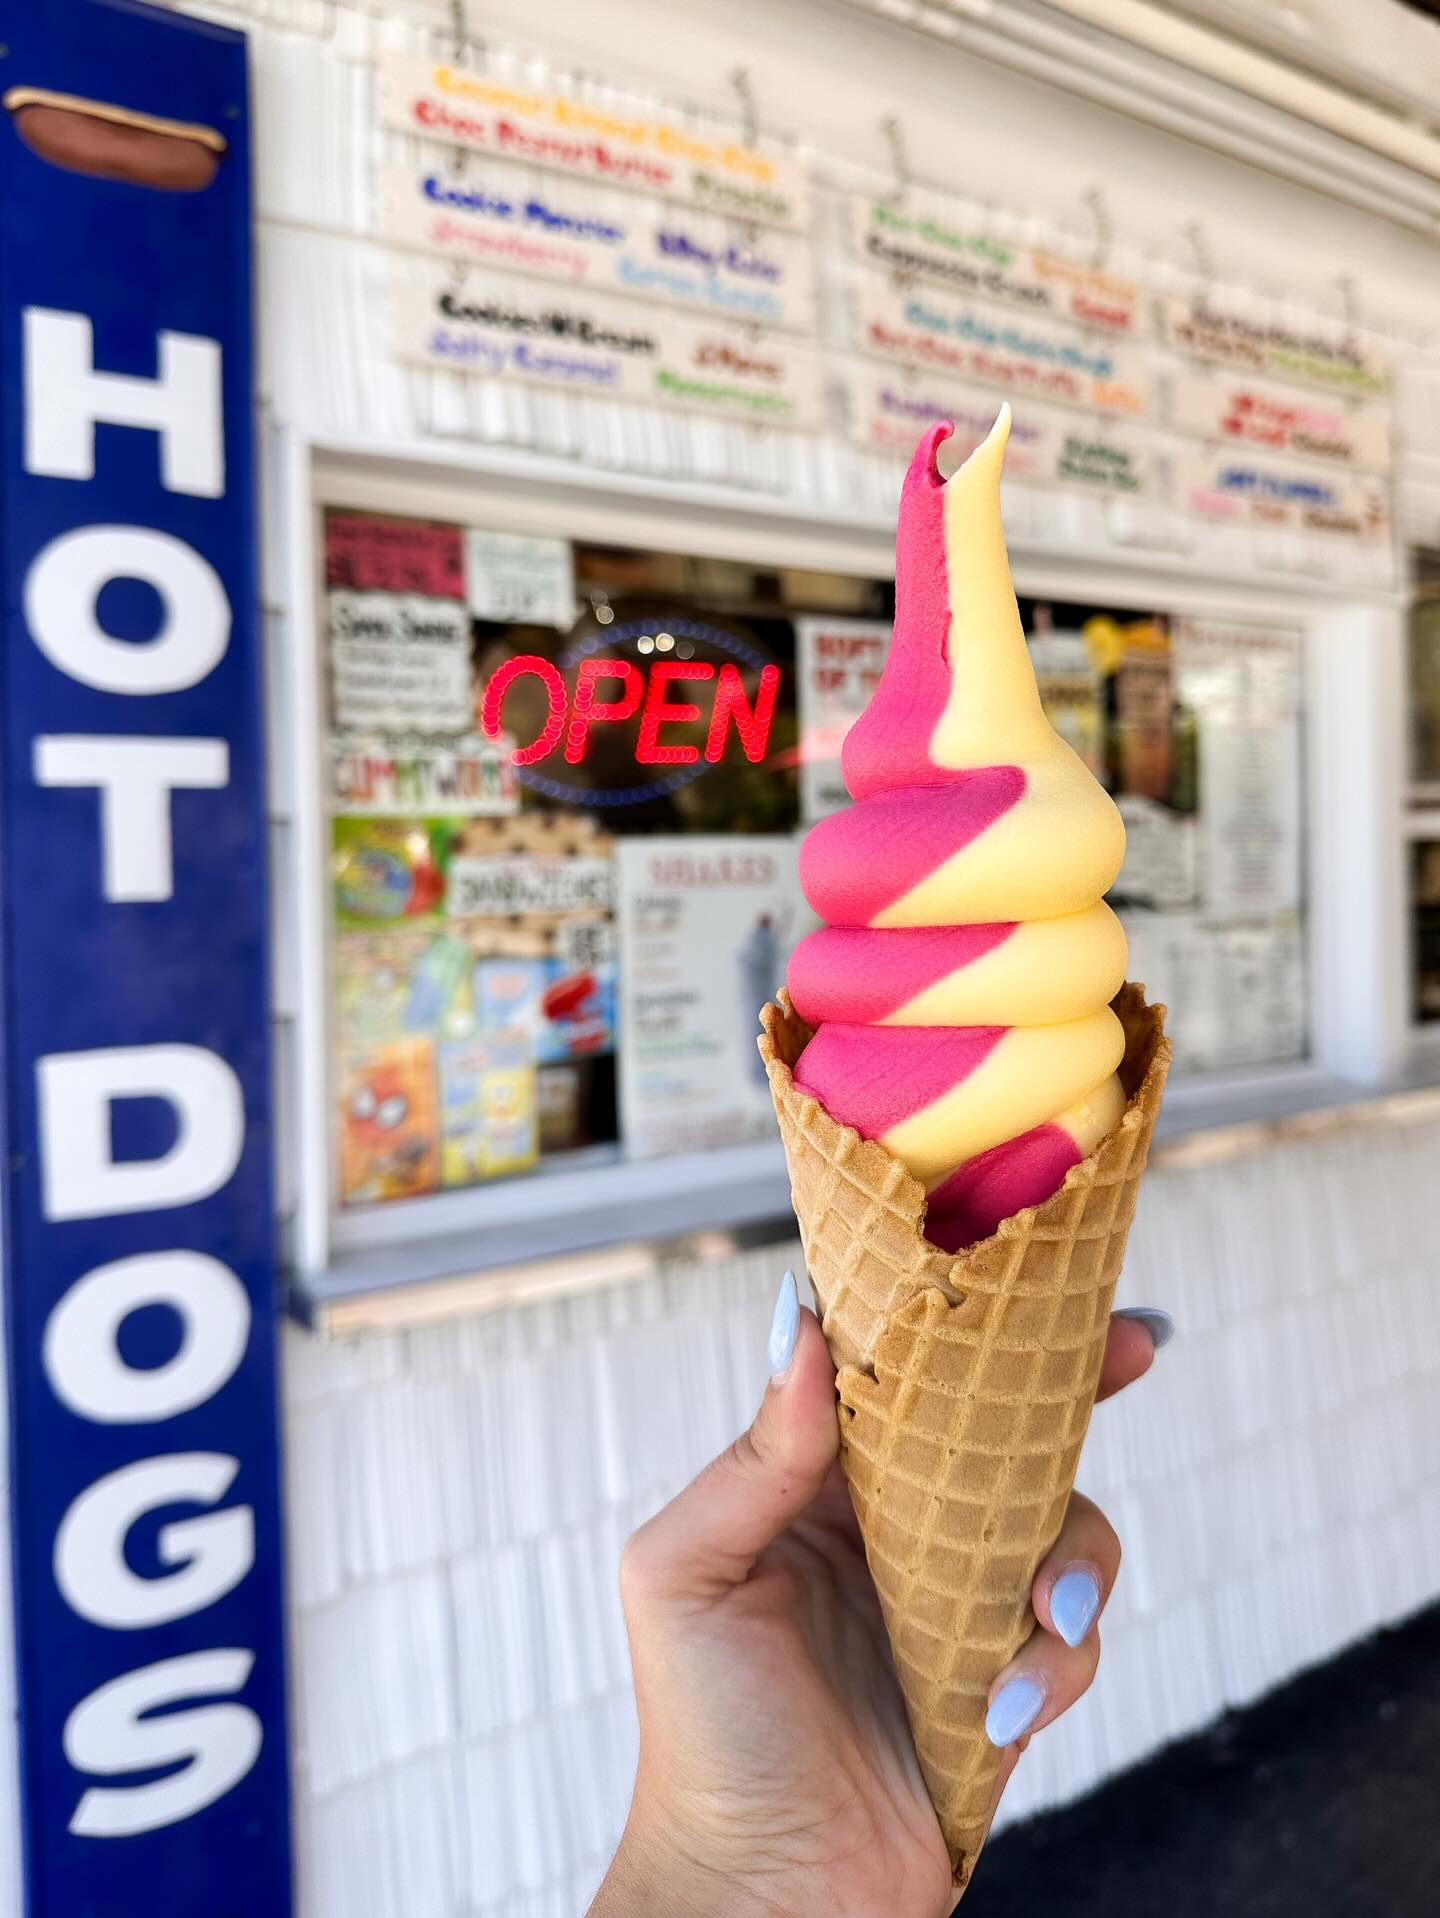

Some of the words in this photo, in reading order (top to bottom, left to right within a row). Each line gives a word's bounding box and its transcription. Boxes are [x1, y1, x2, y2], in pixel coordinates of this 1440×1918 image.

[23, 305, 233, 904] HOT
[481, 655, 780, 766] OPEN
[36, 1042, 264, 1838] DOGS
